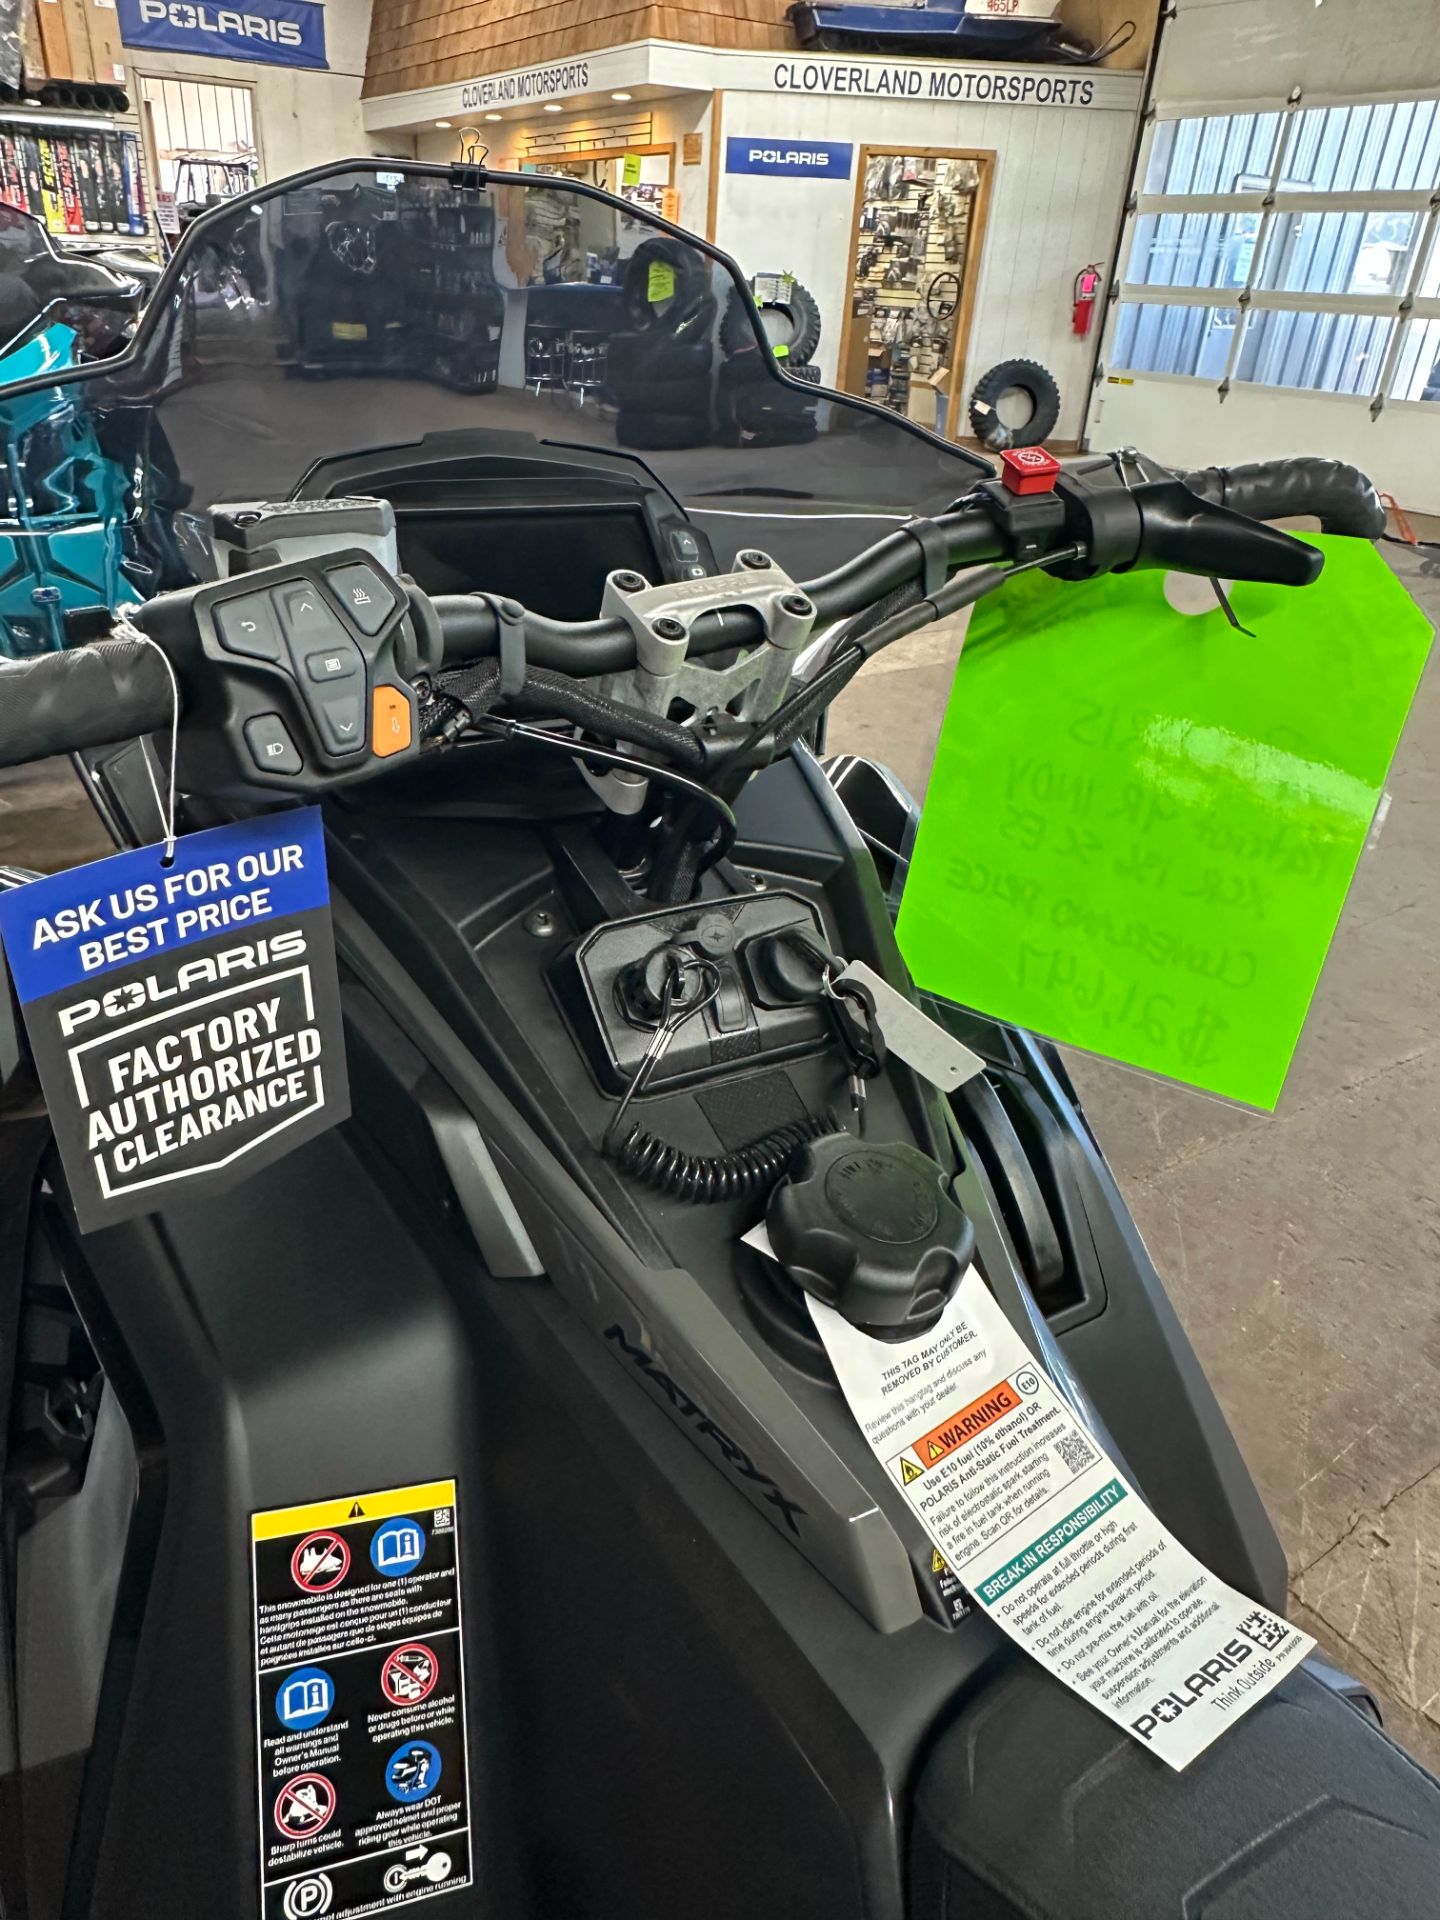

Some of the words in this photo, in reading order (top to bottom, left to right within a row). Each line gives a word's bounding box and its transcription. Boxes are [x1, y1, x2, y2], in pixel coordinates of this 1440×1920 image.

[141, 0, 302, 46] POLARIS
[463, 76, 515, 109] CLOVERLAND
[517, 63, 589, 97] MOTORSPORTS
[774, 63, 922, 96] CLOVERLAND
[929, 72, 1094, 105] MOTORSPORTS
[748, 148, 829, 166] POLARIS
[32, 898, 113, 951] ASK
[109, 880, 160, 921] US
[164, 862, 231, 907] FOR
[237, 843, 305, 885] OUR
[79, 919, 169, 973] BEST
[176, 887, 273, 939] PRICE
[57, 929, 308, 1038] POLARIS
[107, 996, 282, 1095] FACTORY
[87, 1027, 323, 1151] AUTHORIZED
[113, 1069, 309, 1175] CLEARANCE
[881, 1365, 900, 1380] THIS
[901, 1354, 919, 1369] TAG
[920, 1344, 938, 1359] MAY
[938, 1329, 955, 1348] ONLY
[955, 1321, 968, 1333] BE
[881, 1366, 921, 1396] REMOVED
[922, 1358, 934, 1371] BY
[1021, 1377, 1035, 1390] E10
[922, 1475, 941, 1490] Use
[940, 1462, 957, 1478] E10
[957, 1450, 974, 1466] fuel
[973, 1435, 995, 1456] (10%
[994, 1412, 1028, 1440] ethanol)
[1026, 1402, 1041, 1415] OR
[938, 1392, 1012, 1449] WARNING
[919, 1479, 959, 1512] POLARIS
[958, 1450, 1000, 1484] Anti-Static
[999, 1435, 1019, 1453] Fuel
[929, 1504, 956, 1526] Failure
[955, 1498, 964, 1507] to
[963, 1482, 985, 1501] follow
[984, 1473, 998, 1486] this
[997, 1447, 1034, 1476] instruction
[1032, 1423, 1066, 1450] increases
[938, 1523, 953, 1538] risk
[952, 1515, 961, 1527] of
[960, 1486, 1003, 1521] electrostatic
[1001, 1471, 1023, 1490] spark
[1021, 1453, 1049, 1475] starting
[951, 1532, 966, 1545] fire
[964, 1525, 974, 1535] in
[972, 1513, 988, 1529] fuel
[986, 1502, 1004, 1518] tank
[1002, 1488, 1023, 1506] when
[1022, 1469, 1050, 1492] running
[980, 1523, 1001, 1540] Scan
[999, 1511, 1013, 1525] QR
[1012, 1504, 1023, 1516] for
[982, 1551, 1038, 1599] BREAK-IN
[1034, 1487, 1119, 1558] RESPONSIBILITY
[1001, 1603, 1015, 1615] Do
[1013, 1593, 1028, 1607] not
[1026, 1573, 1053, 1597] operate
[1051, 1565, 1061, 1576] at
[1058, 1556, 1072, 1570] full
[1069, 1539, 1095, 1561] throttle
[1093, 1532, 1103, 1542] or
[1100, 1520, 1118, 1536] high
[1022, 1620, 1040, 1635] tank
[1038, 1612, 1048, 1623] of
[1130, 1638, 1254, 1741] POLARIS
[1210, 1684, 1244, 1713] Think
[1237, 1656, 1277, 1697] Outside
